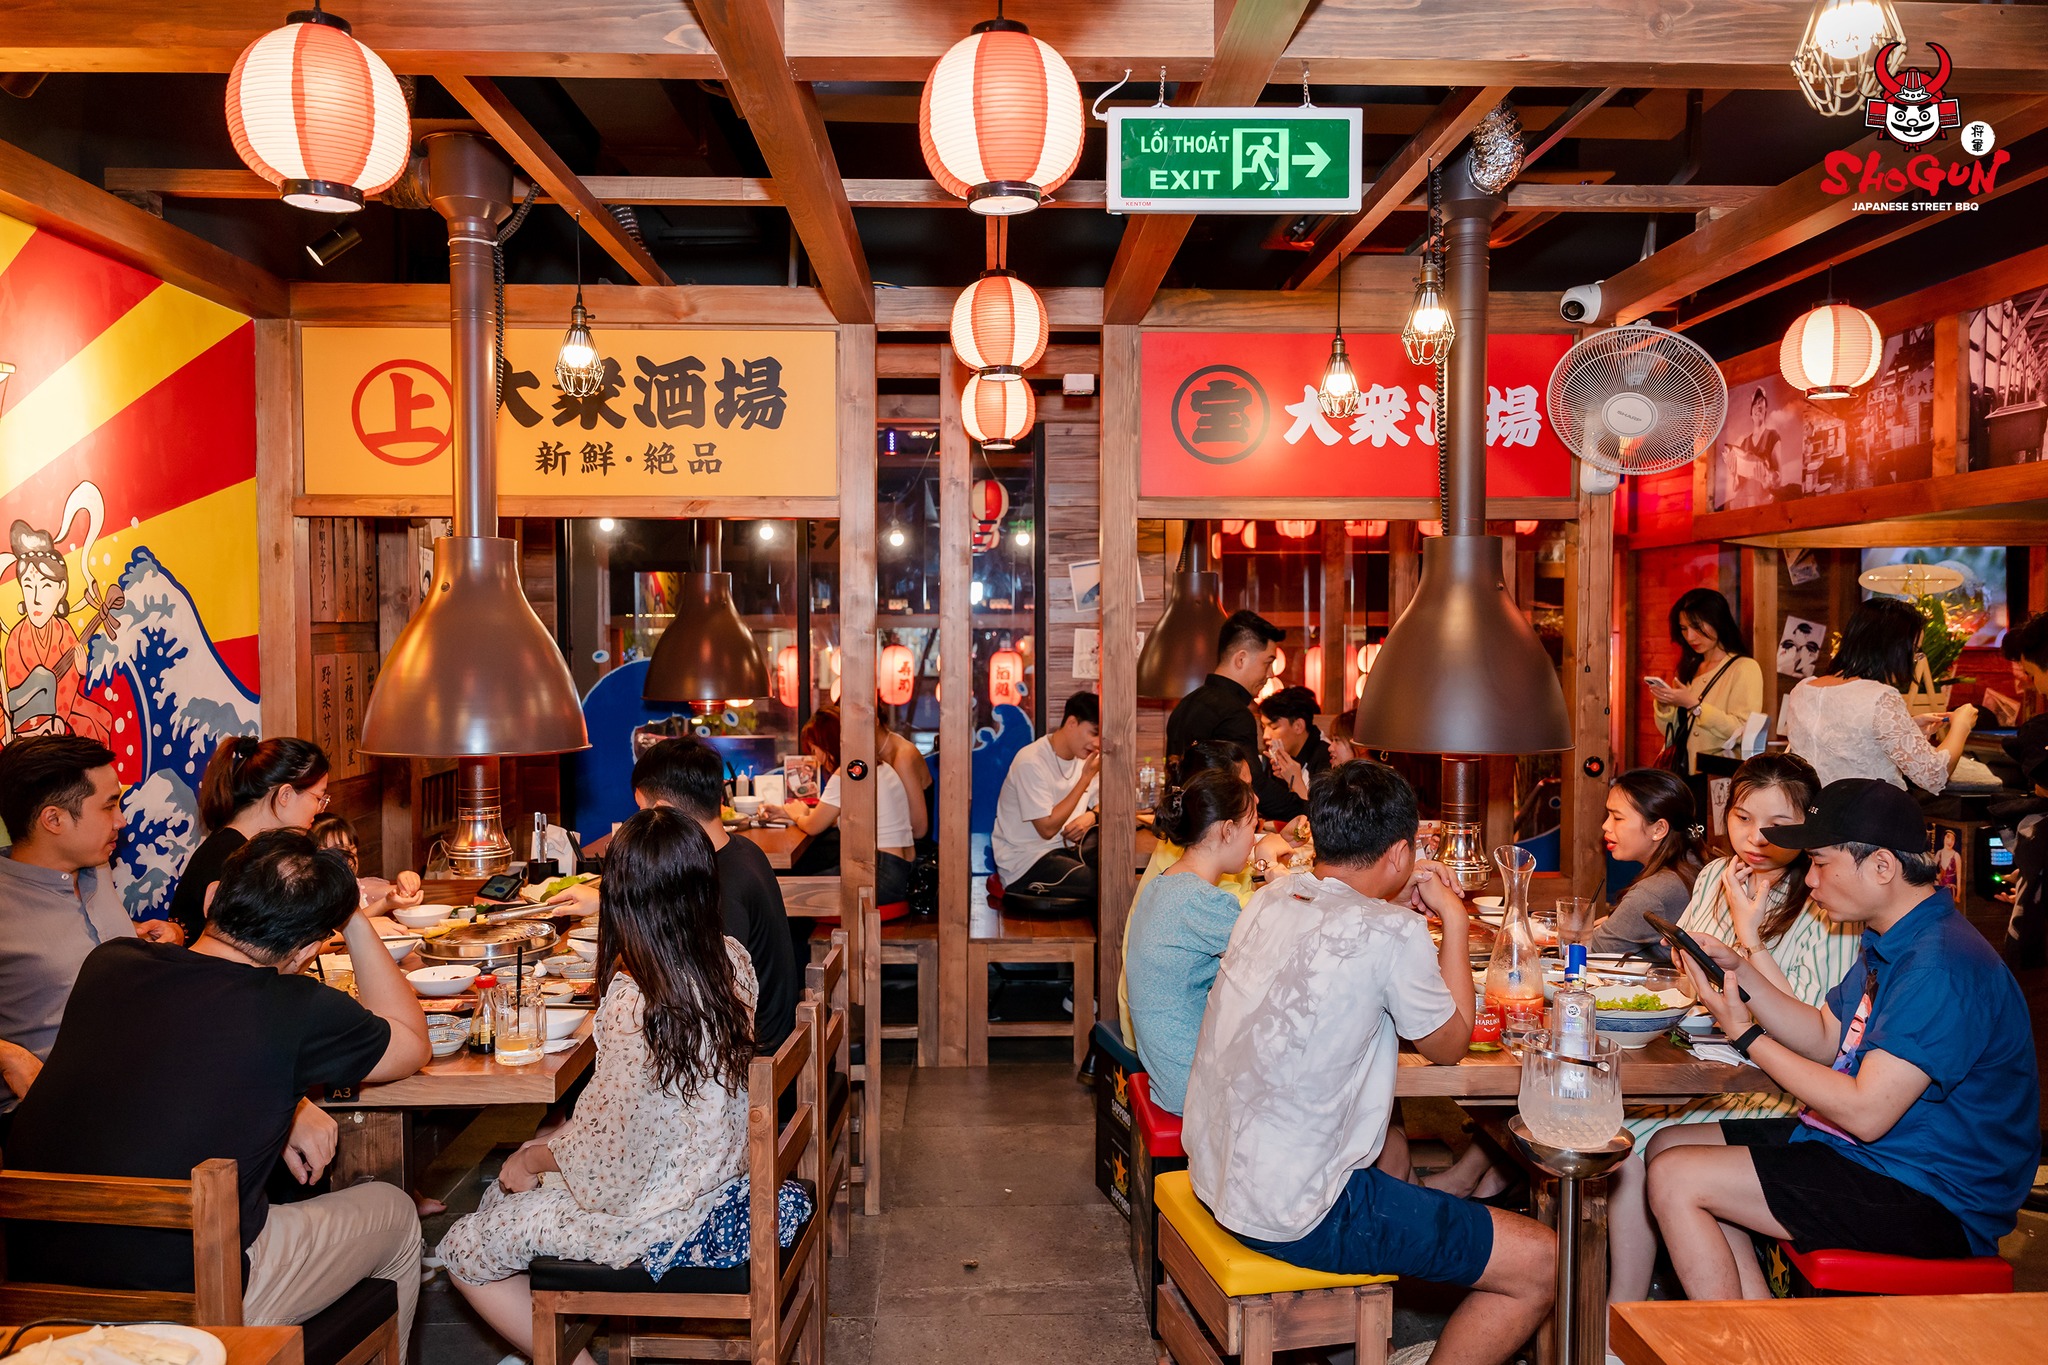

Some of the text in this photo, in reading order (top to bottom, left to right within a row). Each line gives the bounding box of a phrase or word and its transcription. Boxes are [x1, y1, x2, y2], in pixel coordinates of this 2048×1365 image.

[1140, 127, 1230, 153] LỐI THOÁT
[1150, 169, 1221, 190] EXIT
[363, 372, 450, 447] 上
[1617, 410, 1642, 422] SHARP
[332, 1087, 351, 1099] A3
